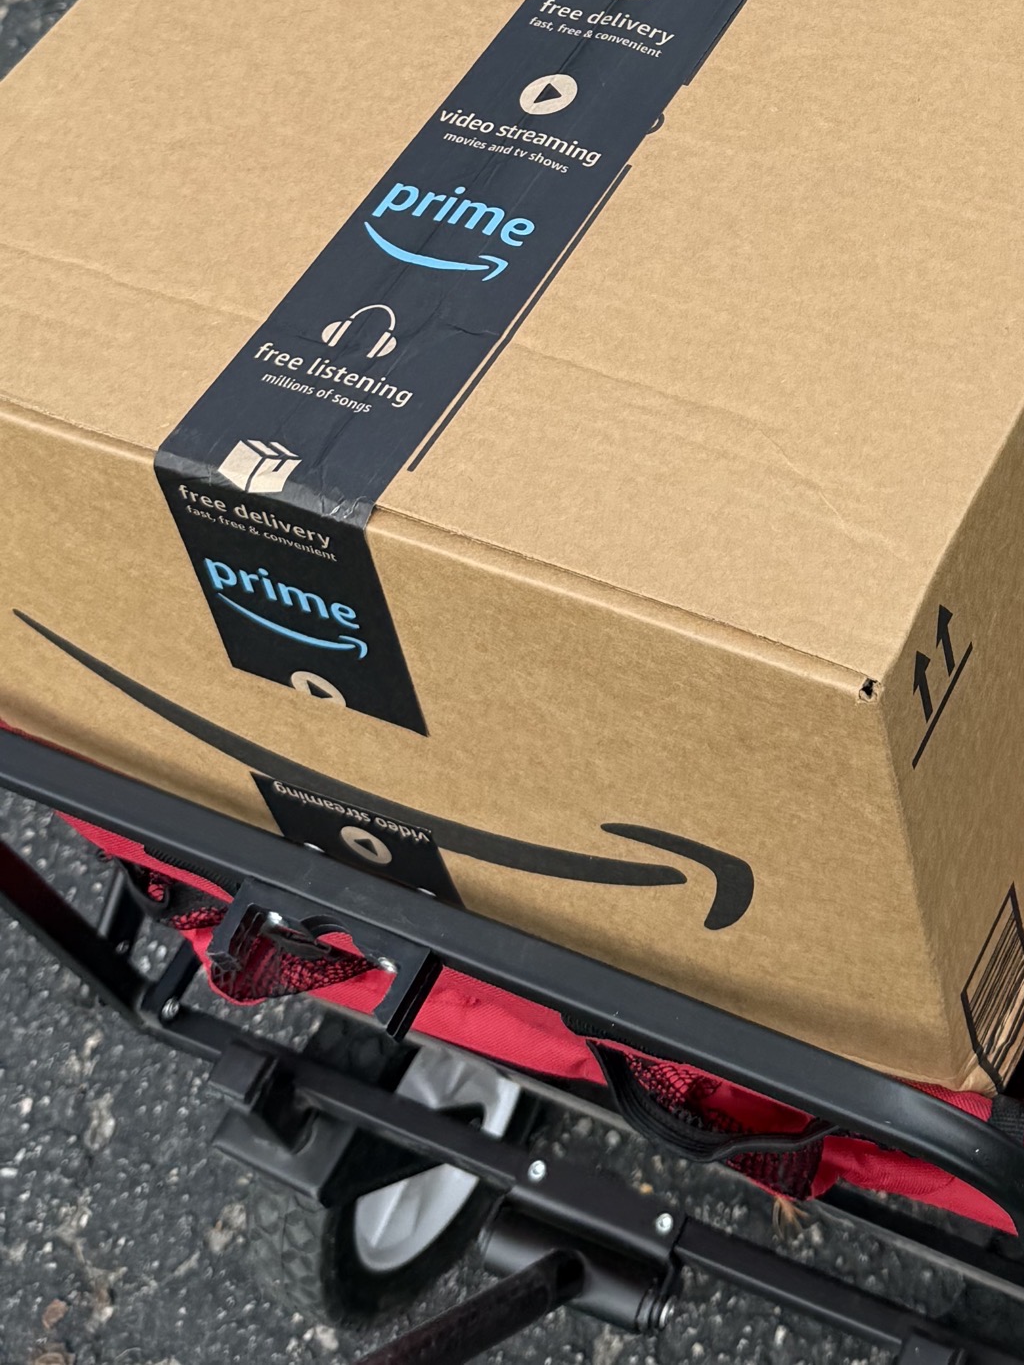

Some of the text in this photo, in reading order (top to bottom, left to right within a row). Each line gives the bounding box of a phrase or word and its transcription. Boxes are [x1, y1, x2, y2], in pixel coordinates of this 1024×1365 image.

[529, 17, 662, 58] fast, free & convenient
[540, 0, 674, 46] free delivery
[439, 109, 602, 168] video streaming
[444, 132, 569, 174] movies and tv shows
[371, 182, 536, 247] prime
[254, 342, 413, 408] free listening
[261, 373, 372, 414] millions of songs
[178, 484, 331, 548] free delivery
[186, 505, 337, 562] fast, free & convenient
[204, 558, 360, 629] prime
[273, 781, 430, 843] video streaming
